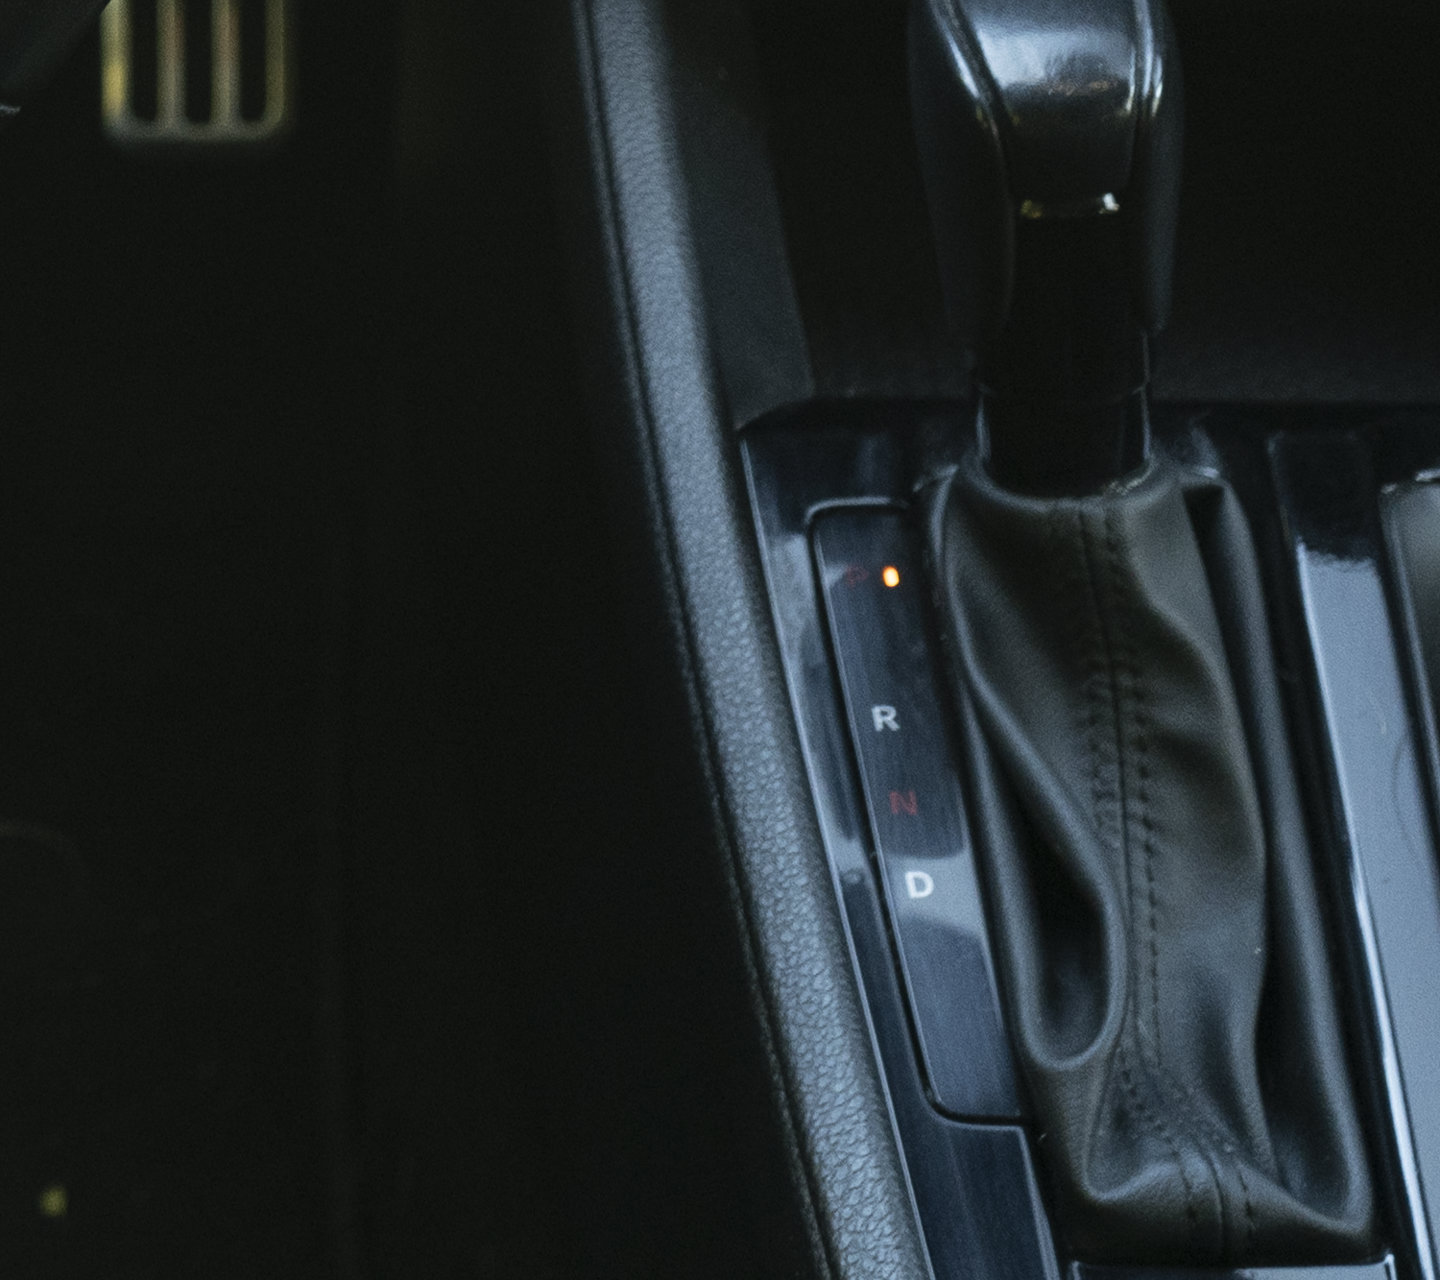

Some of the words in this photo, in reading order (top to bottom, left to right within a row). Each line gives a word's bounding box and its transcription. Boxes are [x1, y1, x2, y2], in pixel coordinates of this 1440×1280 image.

[870, 704, 900, 732] R
[887, 789, 919, 816] N
[905, 870, 934, 898] D
